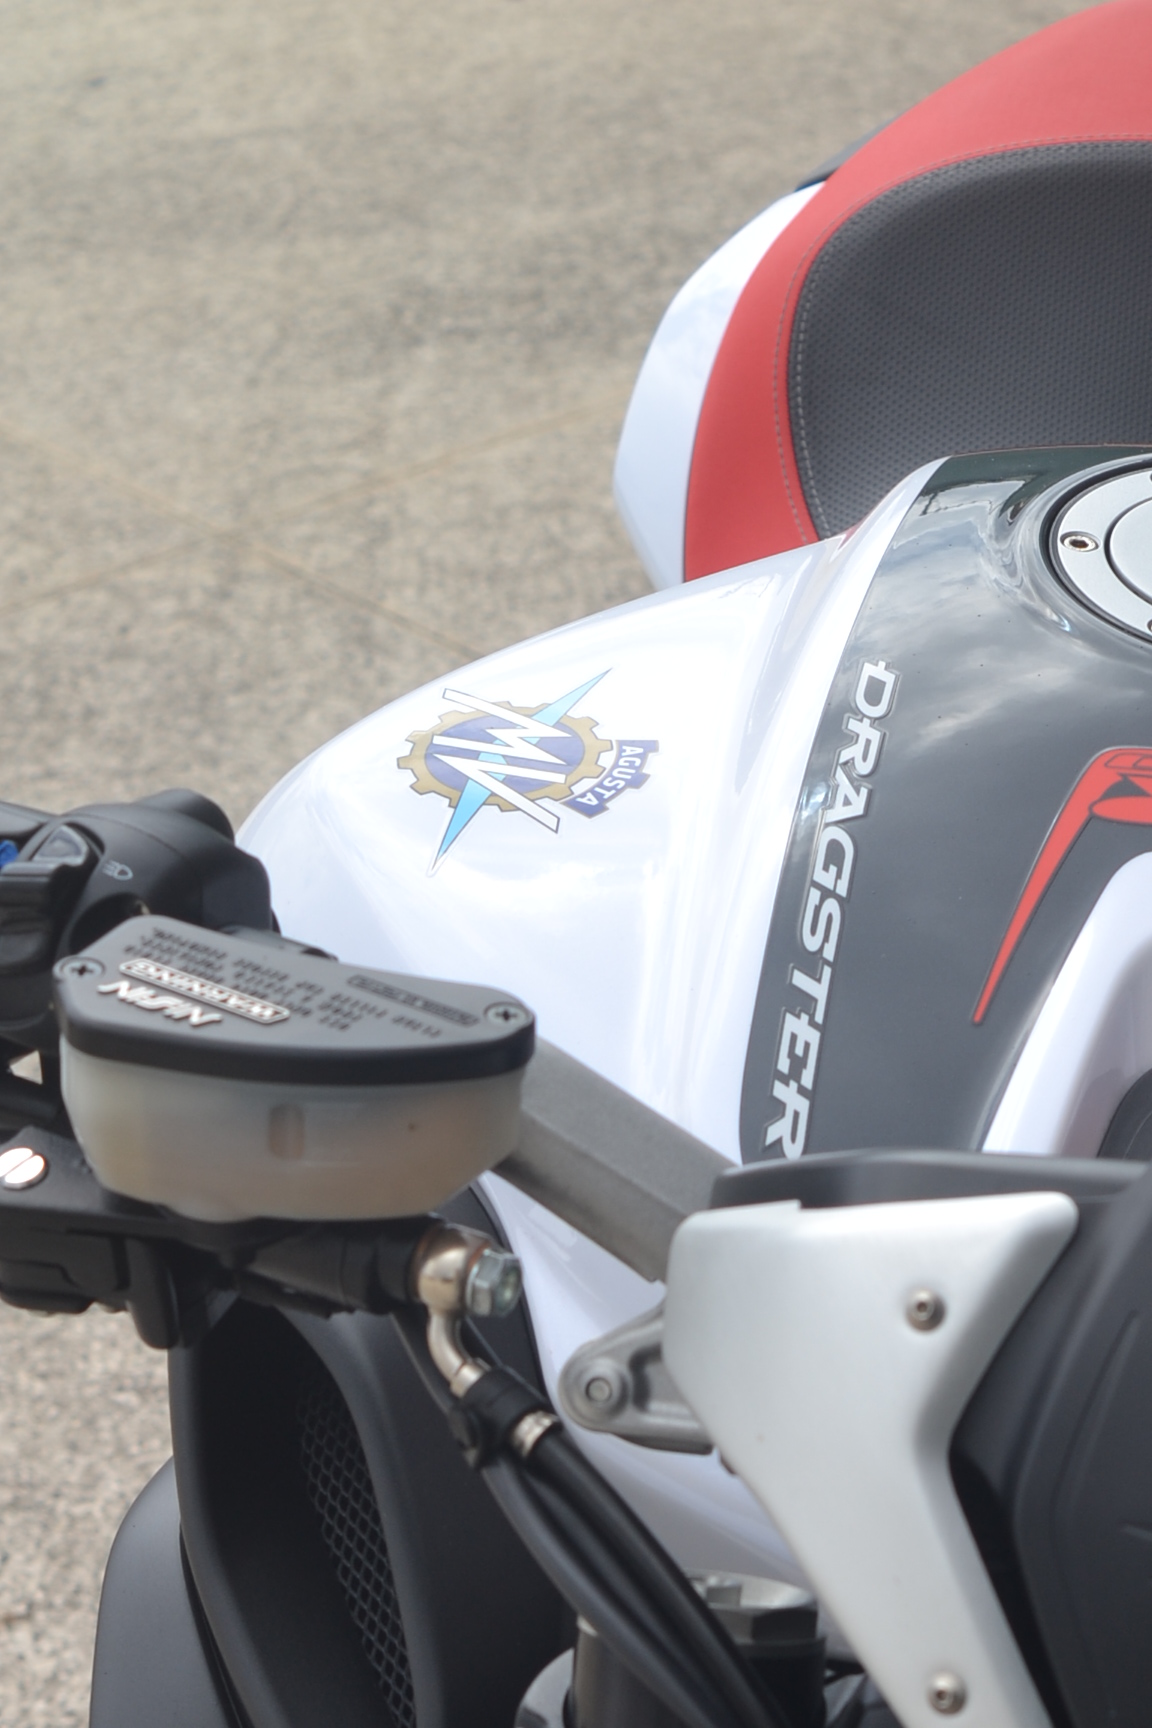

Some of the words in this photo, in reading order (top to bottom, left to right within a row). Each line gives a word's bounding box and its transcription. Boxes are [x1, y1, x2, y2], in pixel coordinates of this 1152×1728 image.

[576, 744, 644, 807] AGUSTA
[764, 660, 896, 1160] DRAGSTER
[131, 959, 280, 1020] WARNING
